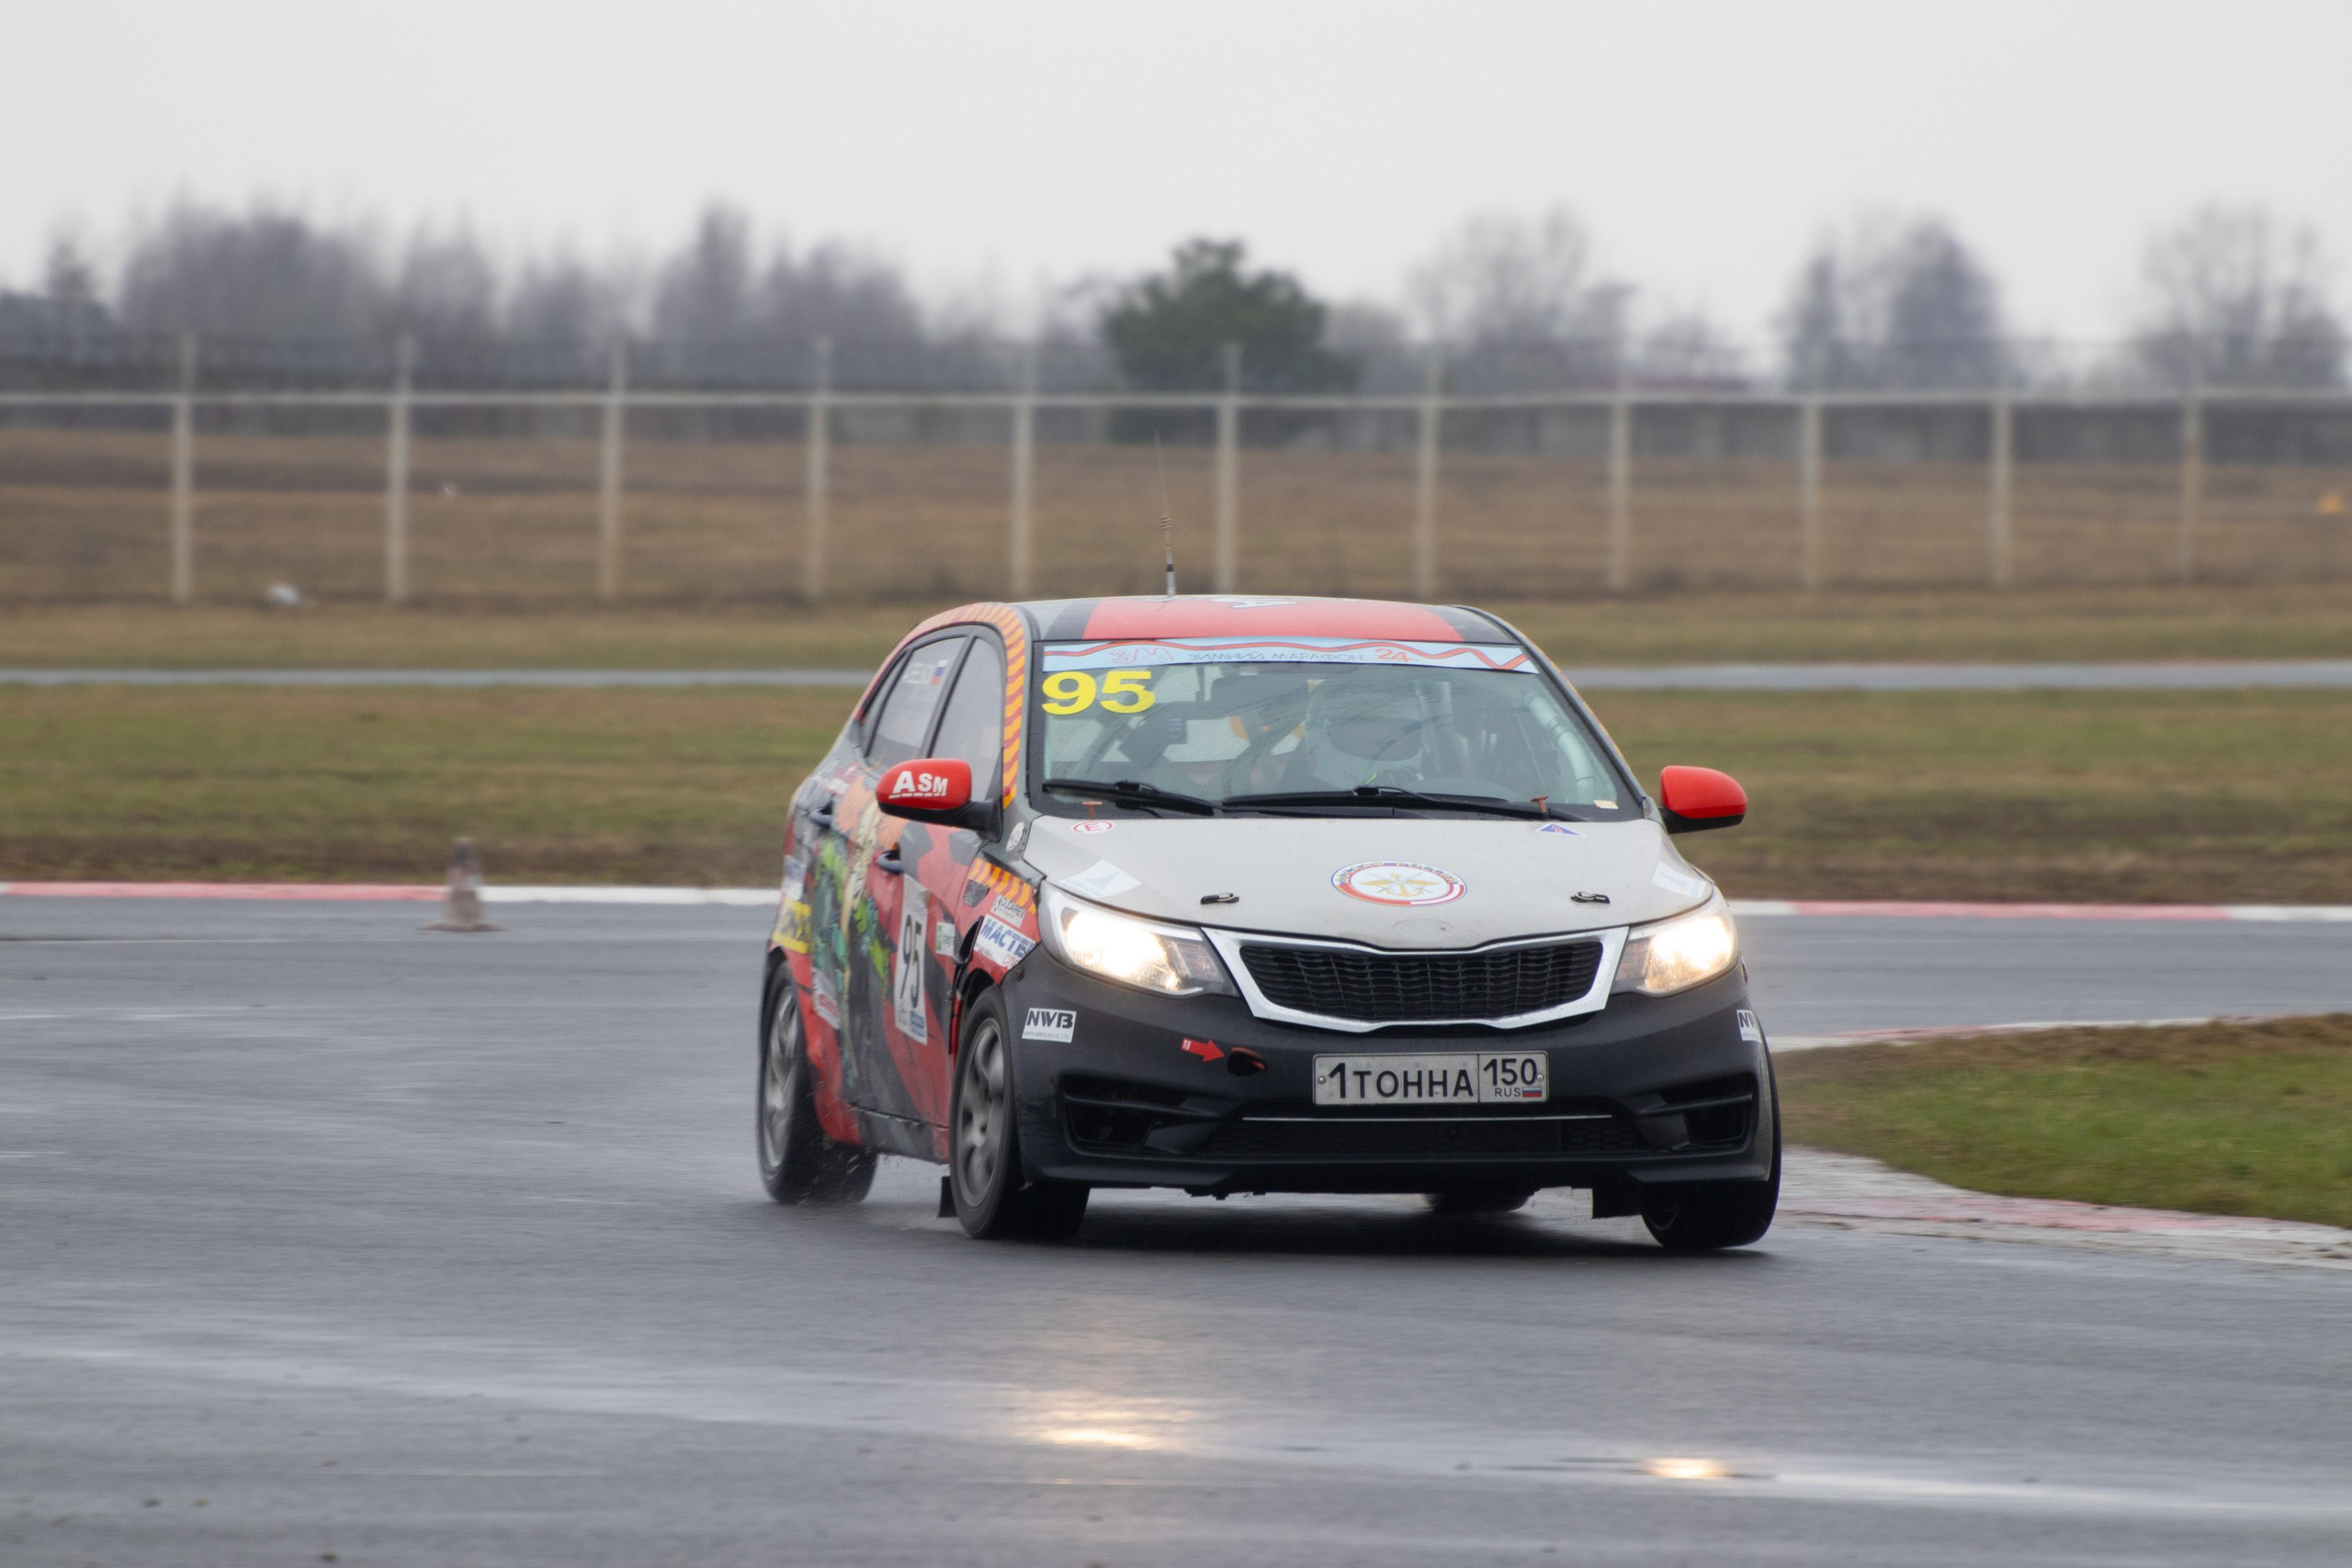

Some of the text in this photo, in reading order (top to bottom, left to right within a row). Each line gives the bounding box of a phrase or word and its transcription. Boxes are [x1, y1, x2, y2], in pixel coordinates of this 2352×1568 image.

[1272, 652, 1364, 662] МАРАФОН
[1041, 670, 1156, 716] 95
[892, 770, 949, 795] ASM
[899, 914, 923, 1009] 95
[1026, 1010, 1074, 1029] NWB
[1483, 1058, 1538, 1087] 150
[1494, 1087, 1521, 1098] RUS
